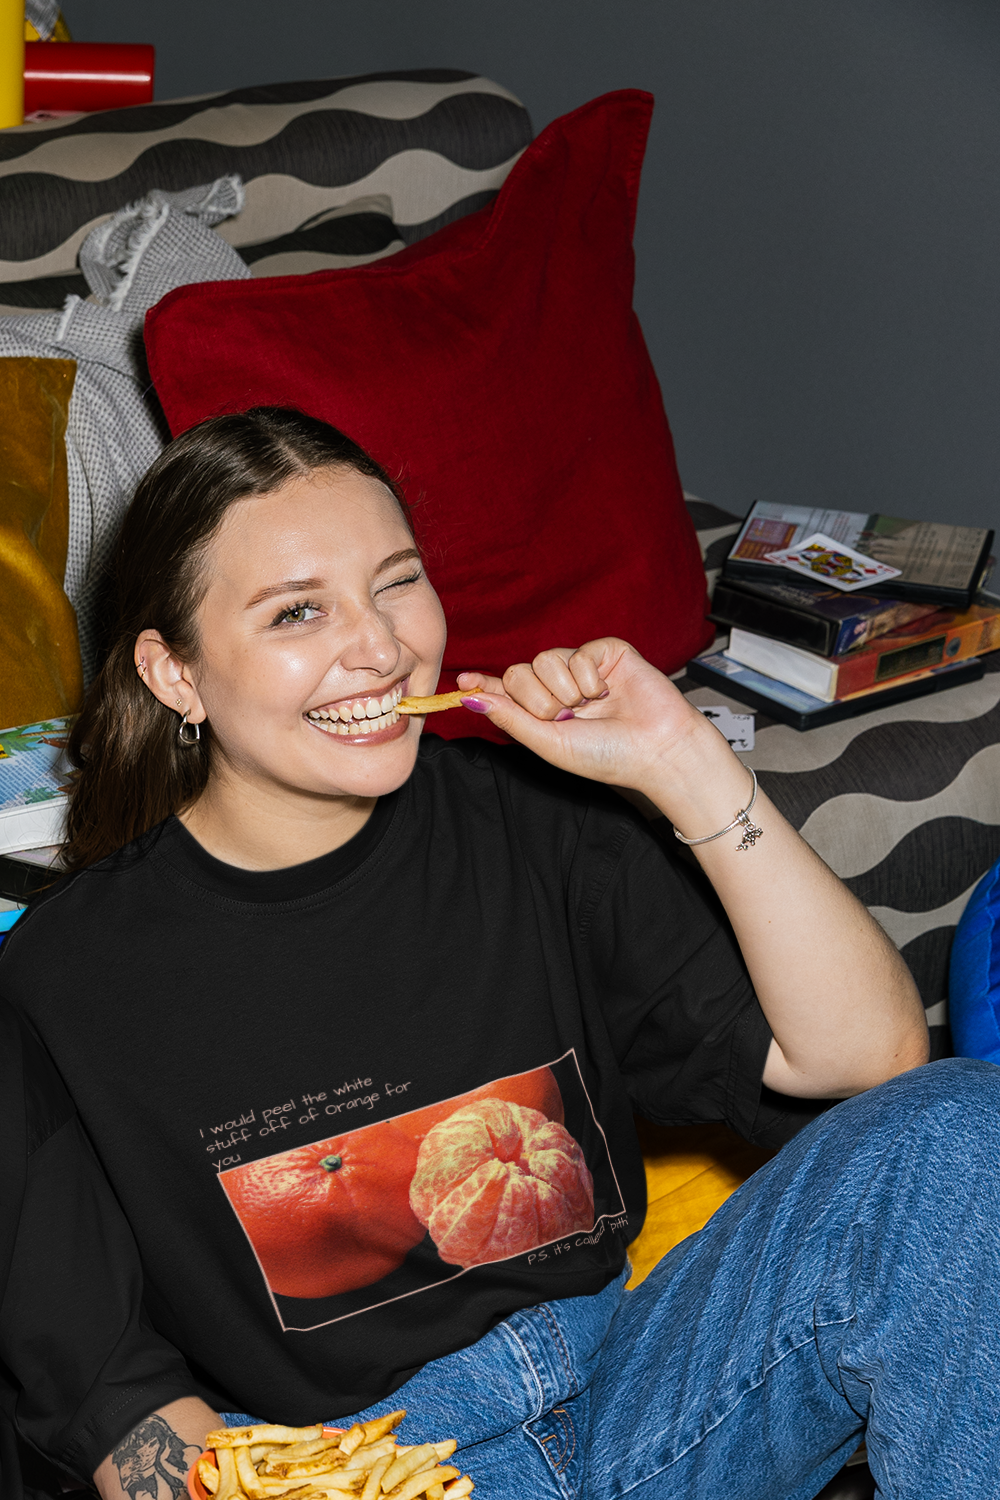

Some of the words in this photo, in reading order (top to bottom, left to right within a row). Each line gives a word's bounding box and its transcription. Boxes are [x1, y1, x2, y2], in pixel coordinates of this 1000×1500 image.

[199, 1129, 204, 1138] I
[209, 1109, 256, 1134] would
[262, 1099, 297, 1123] peel
[301, 1091, 328, 1106] the
[333, 1077, 373, 1096] white
[206, 1127, 252, 1153] stuff
[259, 1116, 292, 1136] off
[298, 1107, 320, 1125] of
[325, 1091, 380, 1115] Orange
[384, 1081, 412, 1097] for
[212, 1154, 242, 1173] you
[552, 1243, 571, 1255] it's
[574, 1219, 605, 1247] called
